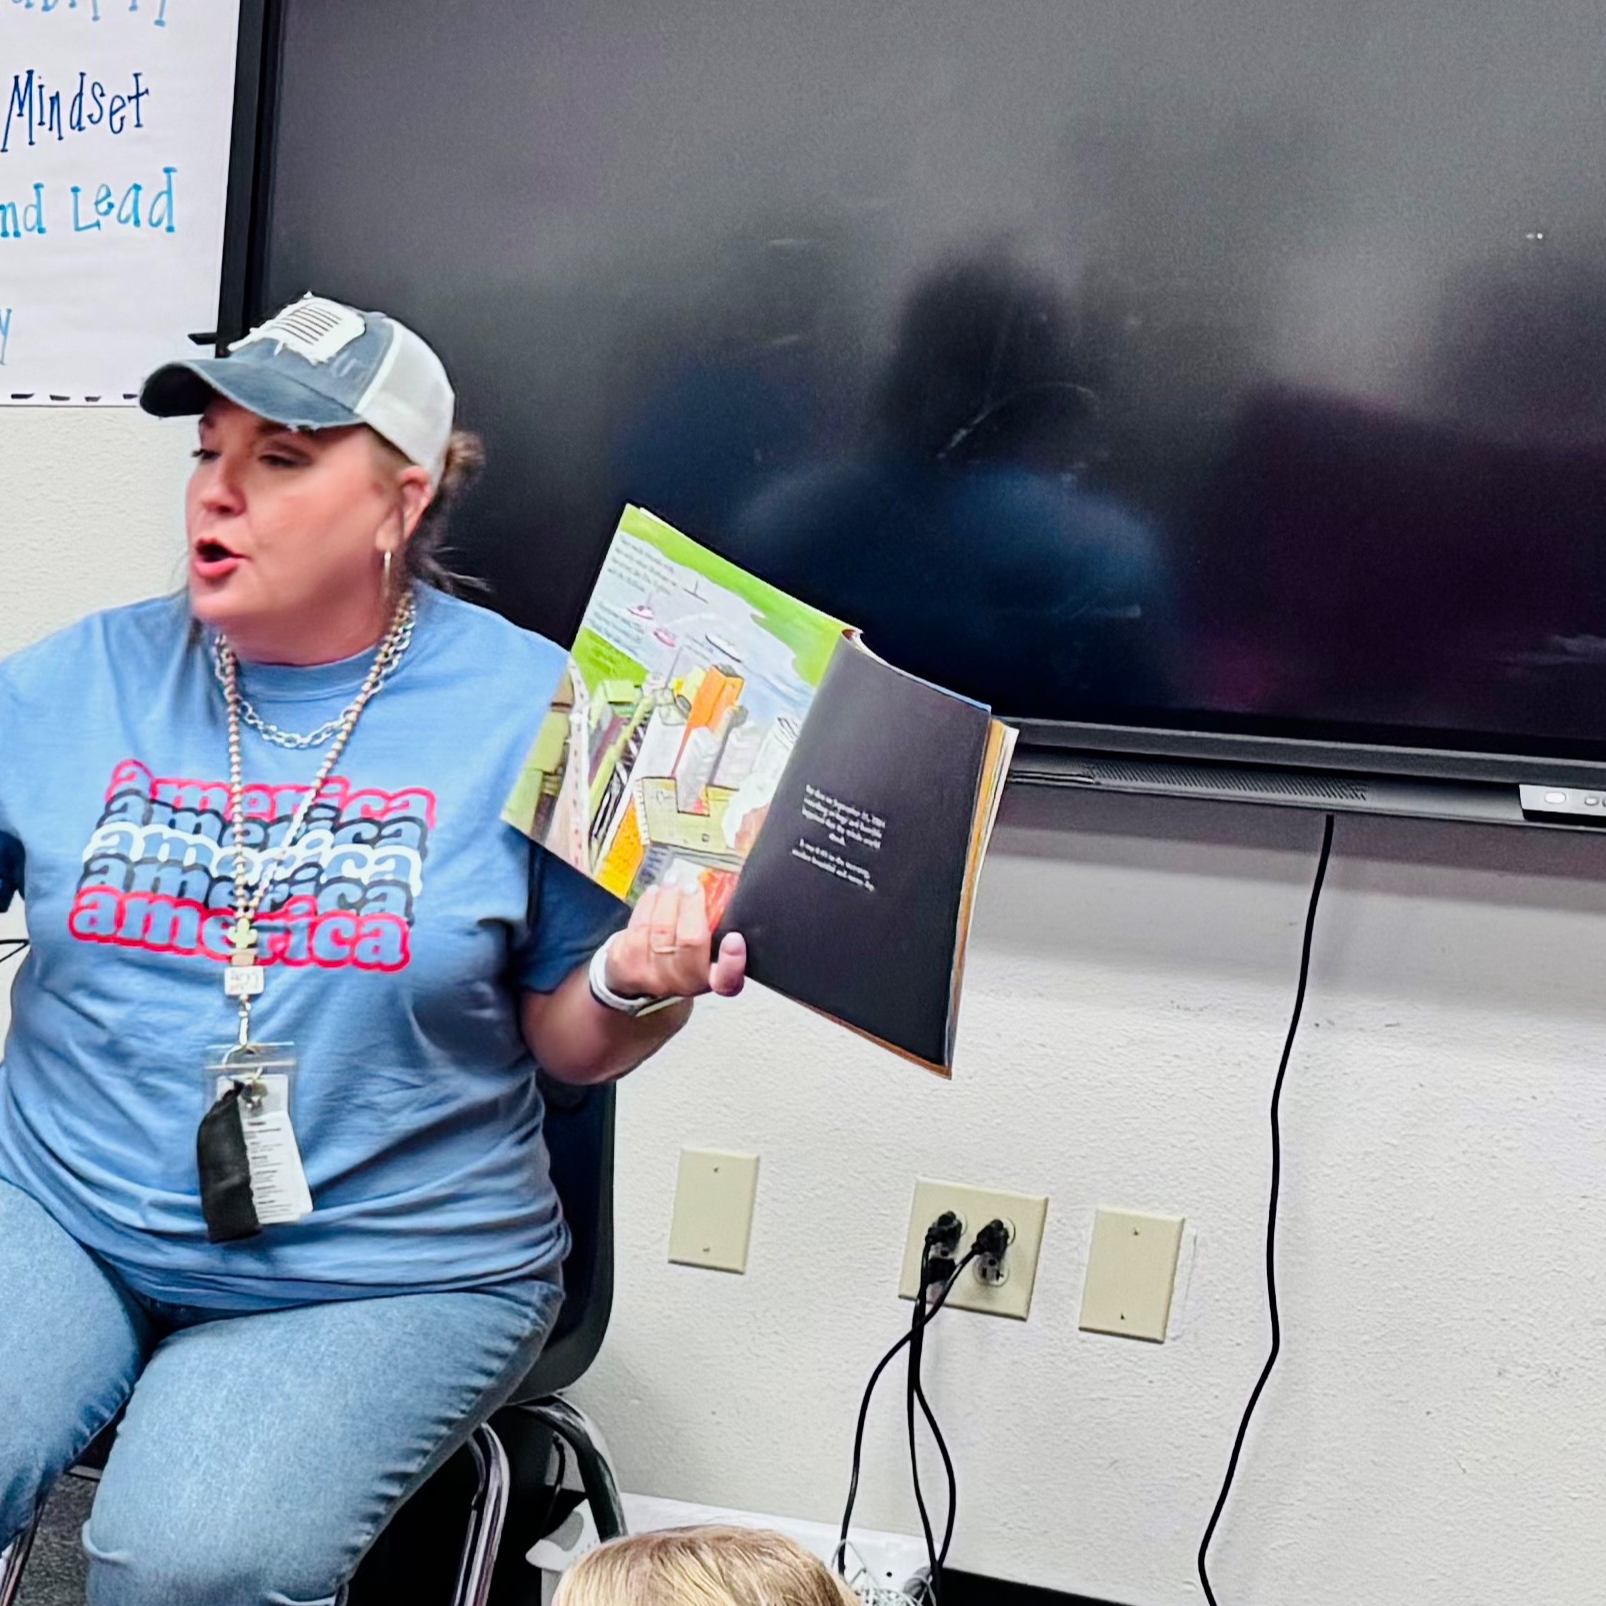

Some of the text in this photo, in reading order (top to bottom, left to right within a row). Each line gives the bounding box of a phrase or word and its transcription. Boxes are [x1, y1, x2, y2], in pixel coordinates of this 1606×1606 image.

[0, 69, 150, 153] Mindset
[70, 166, 178, 234] Lead
[106, 759, 437, 830] america
[82, 823, 424, 897] america
[68, 885, 412, 974] america
